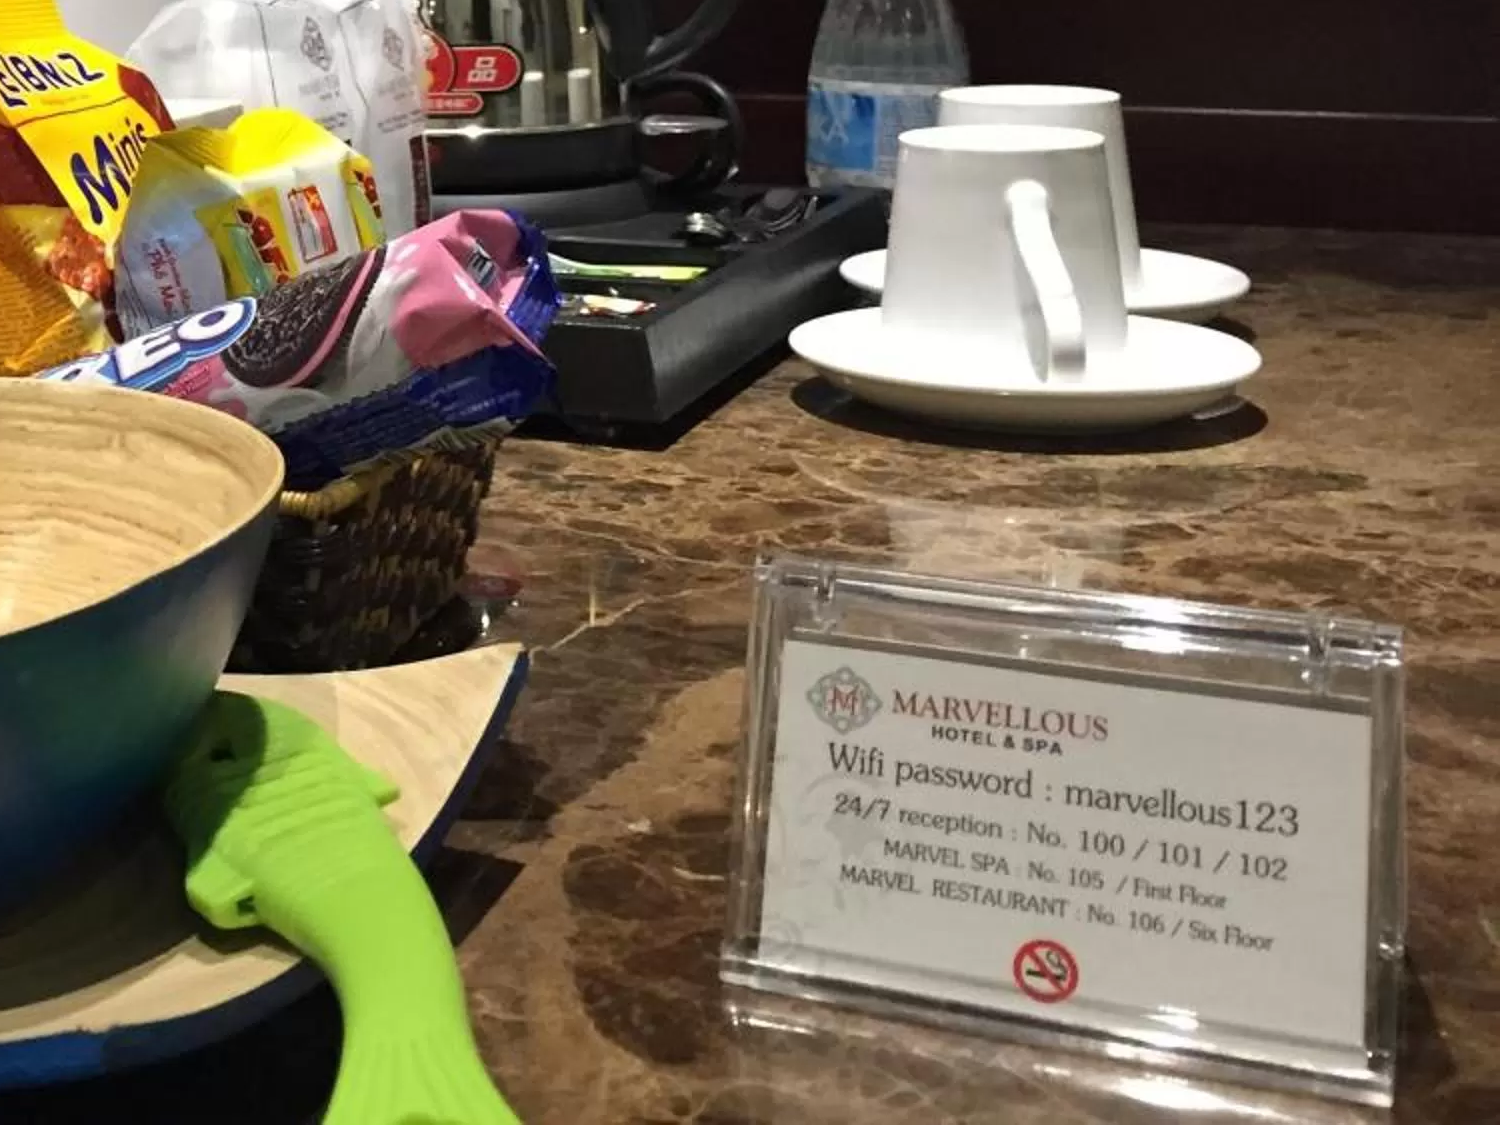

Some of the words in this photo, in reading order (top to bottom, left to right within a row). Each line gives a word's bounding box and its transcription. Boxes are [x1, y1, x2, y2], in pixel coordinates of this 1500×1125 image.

[71, 117, 148, 225] Minis
[49, 302, 245, 381] REO
[892, 690, 1109, 742] MARVELLOUS
[931, 725, 996, 747] HOTEL
[1003, 735, 1016, 750] &
[1022, 737, 1063, 756] SPA
[828, 741, 884, 777] Wifi
[895, 758, 1033, 799] password
[1065, 784, 1299, 837] marvellous123
[834, 792, 891, 820] 24/7
[899, 809, 1003, 839] reception
[1027, 821, 1068, 849] No.
[1079, 830, 1125, 857] 100
[1159, 841, 1202, 869] 101
[1240, 853, 1289, 882] 102
[883, 838, 966, 869] MARVEL
[970, 852, 1011, 876] SPA
[1069, 867, 1104, 890] 105
[1133, 877, 1173, 901] First
[1179, 884, 1227, 909] Floor
[840, 863, 921, 894] MARVEL
[932, 878, 1069, 918] RESTAURANT
[1129, 910, 1165, 934] 106
[1188, 920, 1218, 944] Six
[1224, 924, 1275, 952] Floor
